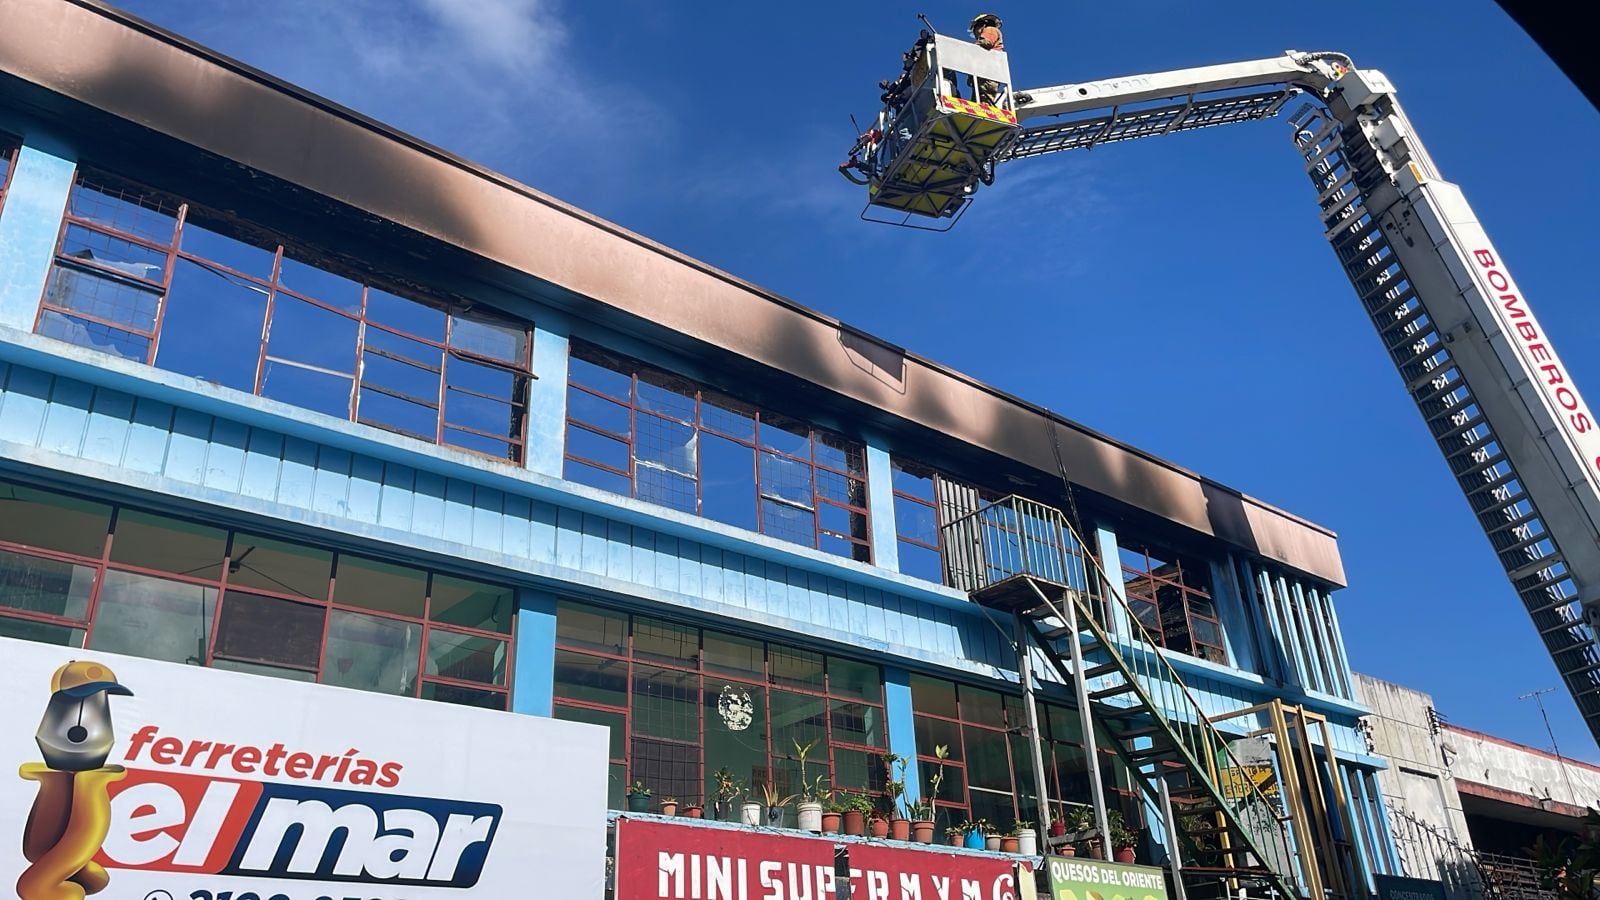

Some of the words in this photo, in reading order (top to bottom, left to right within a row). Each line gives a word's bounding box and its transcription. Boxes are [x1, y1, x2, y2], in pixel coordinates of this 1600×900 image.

[1473, 248, 1592, 434] BOMBEROS
[124, 725, 403, 788] ferreterías
[101, 780, 241, 867] el
[239, 797, 494, 882] mar
[658, 851, 748, 900] MINI
[1051, 861, 1099, 883] QUESOS
[1100, 868, 1121, 886] DEL
[1121, 871, 1163, 890] ORIENTE
